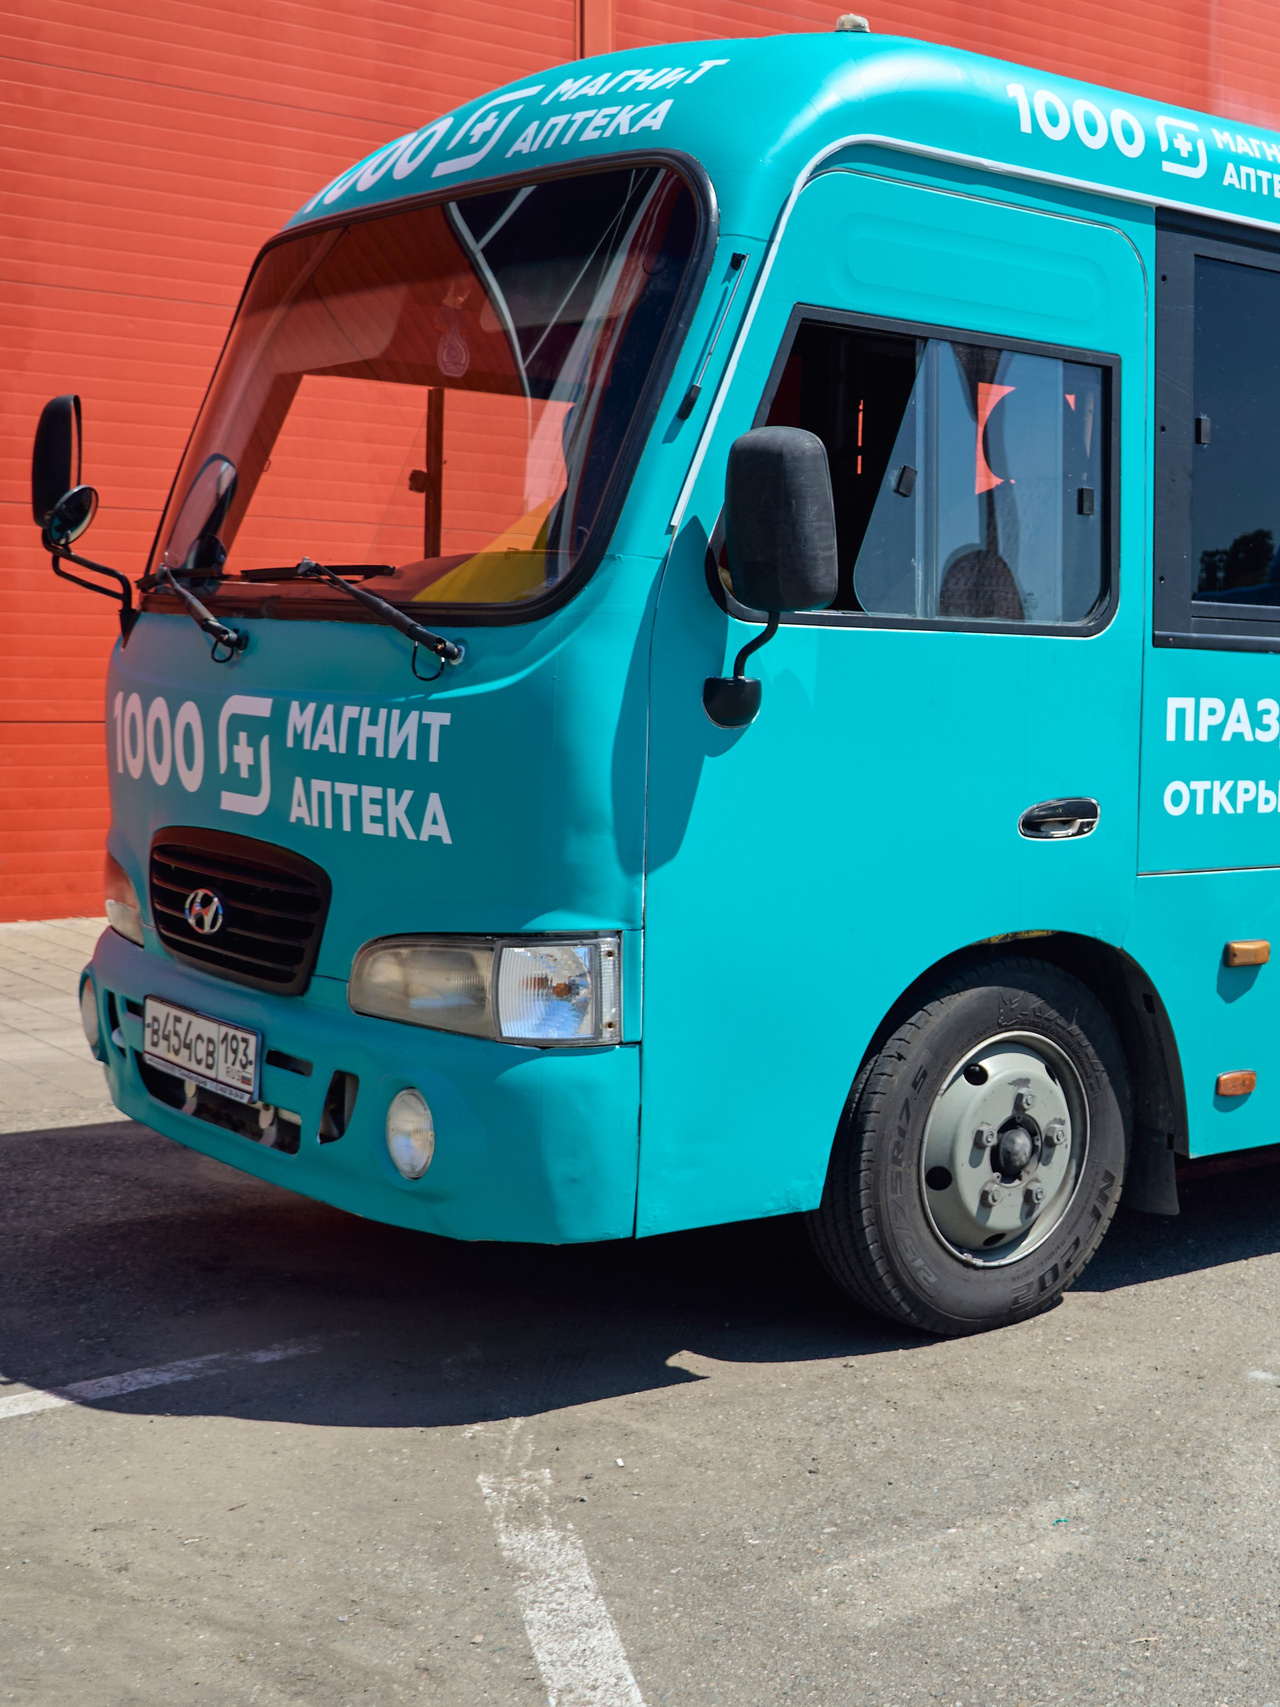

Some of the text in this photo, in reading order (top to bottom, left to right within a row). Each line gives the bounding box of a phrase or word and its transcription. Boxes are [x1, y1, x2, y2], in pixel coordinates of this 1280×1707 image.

[541, 59, 730, 105] МАГНИТ
[504, 99, 674, 158] АПТЕКА
[1006, 83, 1145, 158] 1000
[303, 117, 454, 213] 1000
[114, 691, 204, 793] 1000
[286, 700, 451, 763] МАГНИТ
[289, 776, 453, 845] АПТЕКА
[221, 1031, 250, 1070] 193
[225, 1066, 241, 1082] RUS
